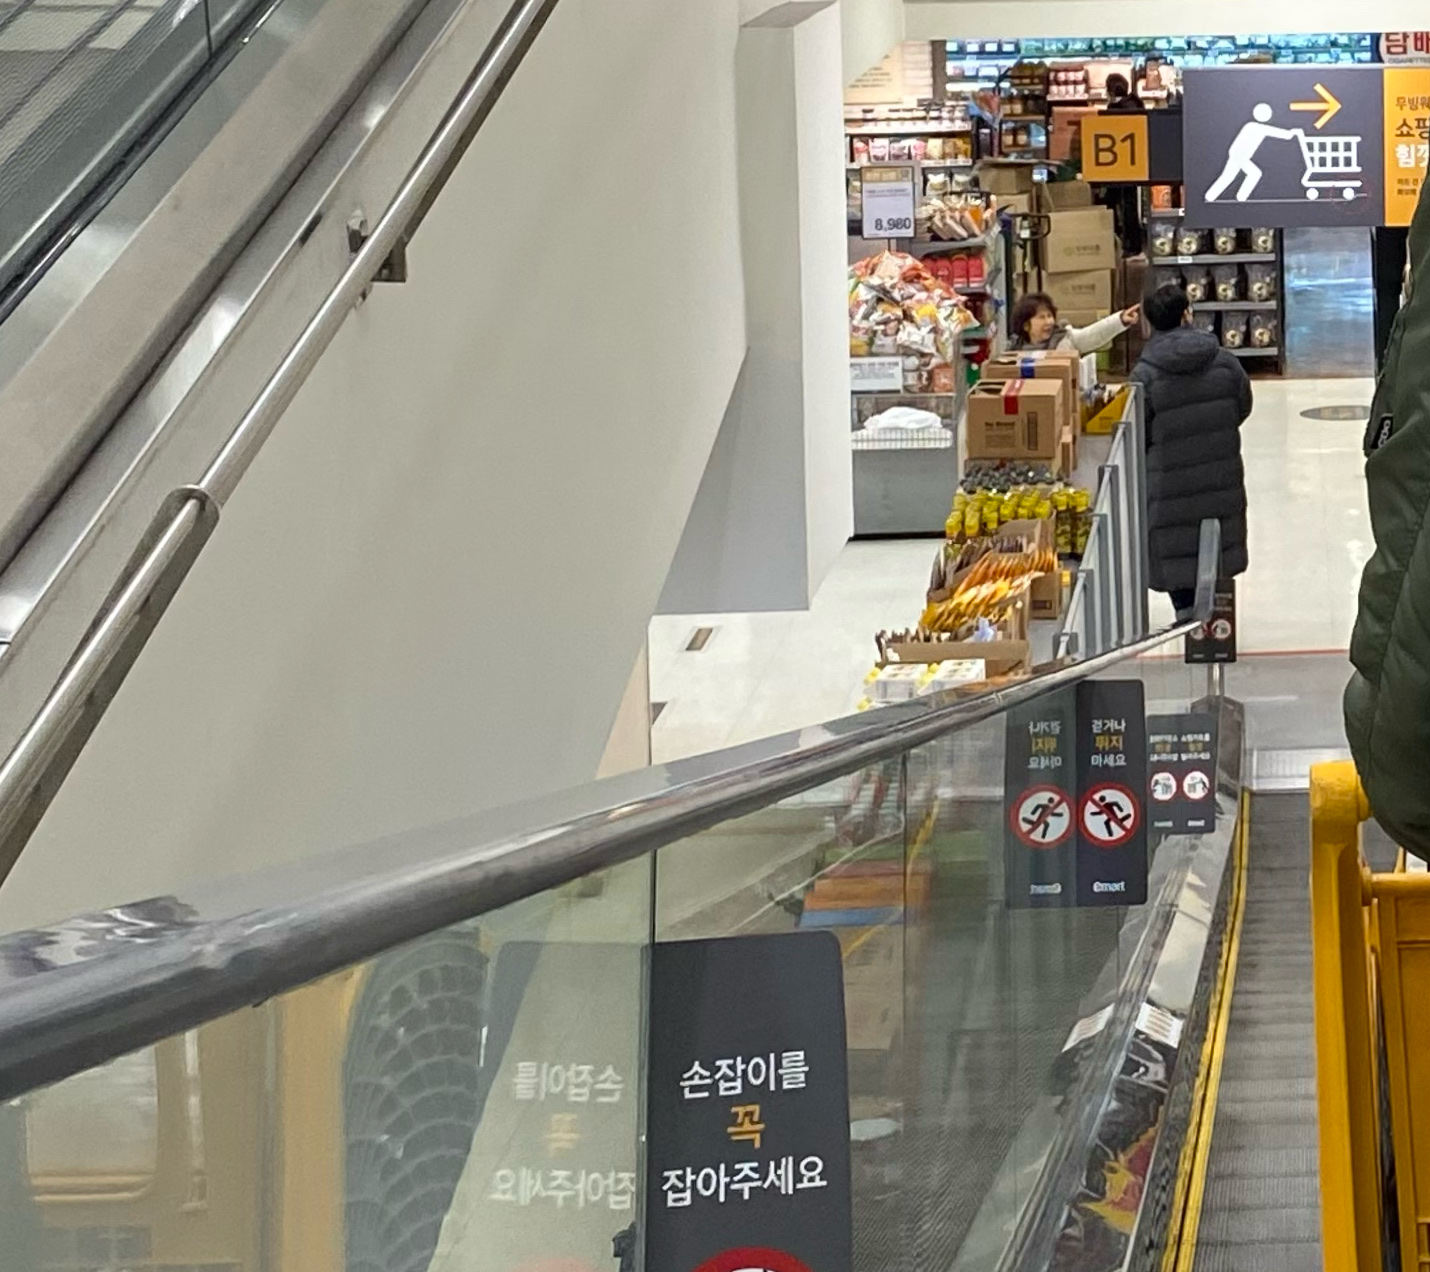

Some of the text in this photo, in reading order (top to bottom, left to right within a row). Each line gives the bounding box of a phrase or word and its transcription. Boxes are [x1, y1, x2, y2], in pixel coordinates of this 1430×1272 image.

[1093, 132, 1137, 167] B1
[1091, 718, 1127, 734] 걷거나
[1091, 753, 1127, 768] 마세요
[1093, 881, 1126, 893] emart
[679, 1049, 810, 1101] 손잡이를
[726, 1103, 766, 1149] 꼭
[661, 1155, 828, 1210] 잡아주세요
